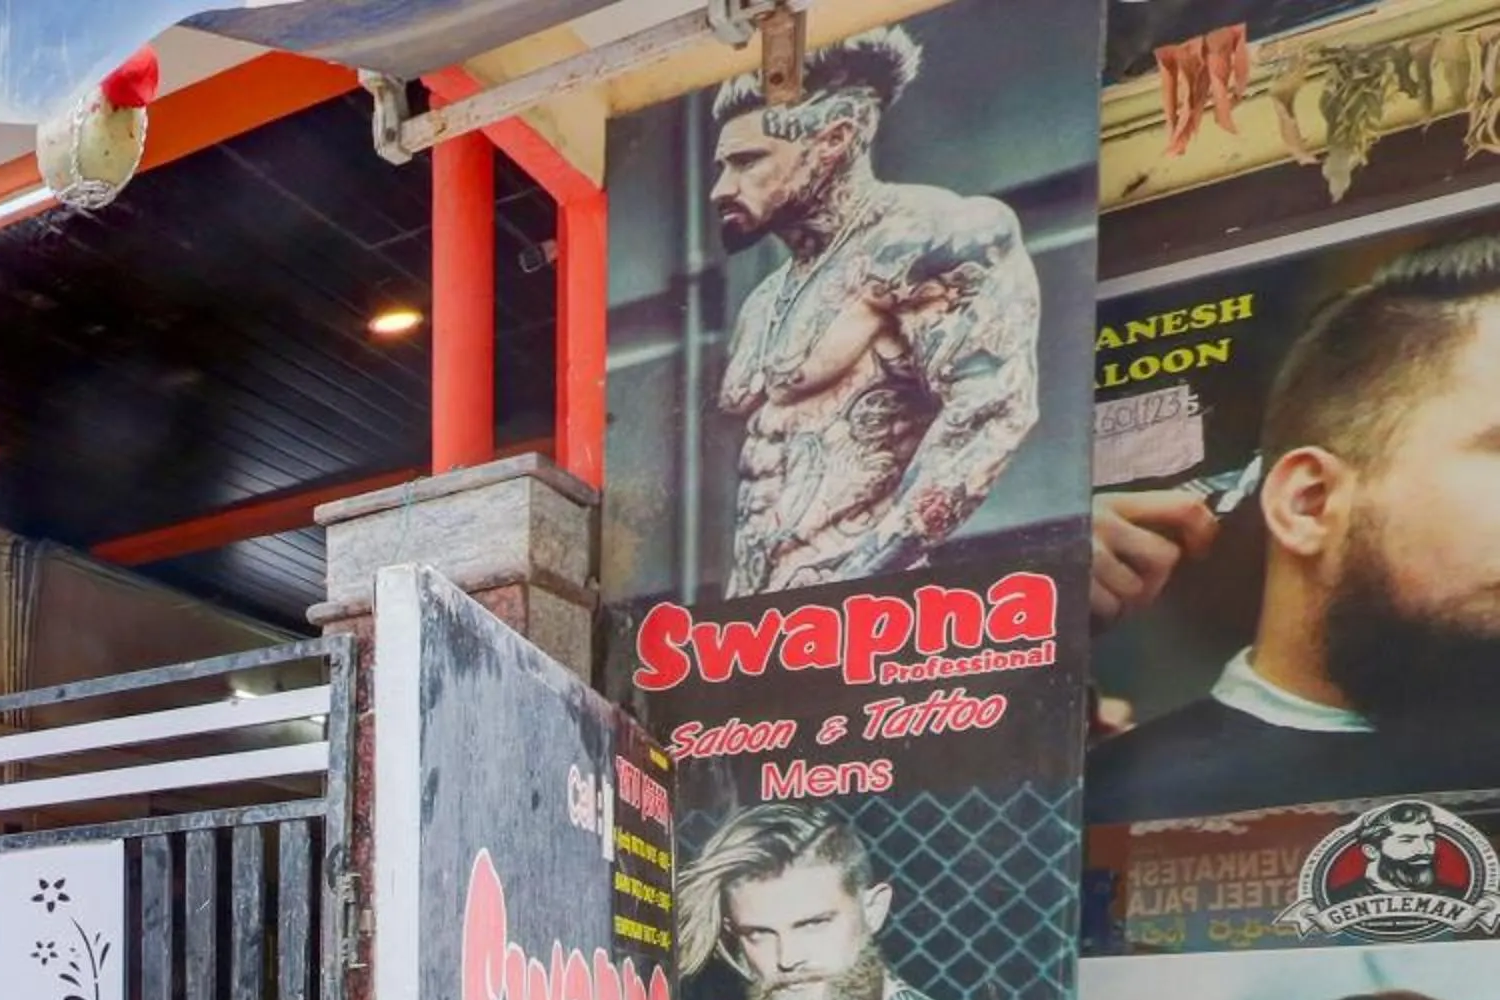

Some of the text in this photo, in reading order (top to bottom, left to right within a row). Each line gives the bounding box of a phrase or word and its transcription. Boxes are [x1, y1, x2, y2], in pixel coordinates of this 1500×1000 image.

[1094, 337, 1232, 388] LOON
[633, 572, 1057, 691] Swapna
[880, 640, 1056, 685] Professional
[666, 718, 796, 760] Saloon
[816, 714, 849, 745] &
[862, 688, 1007, 739] Tattoo
[761, 759, 893, 800] Mens
[1328, 897, 1466, 925] GENTLEMAN
